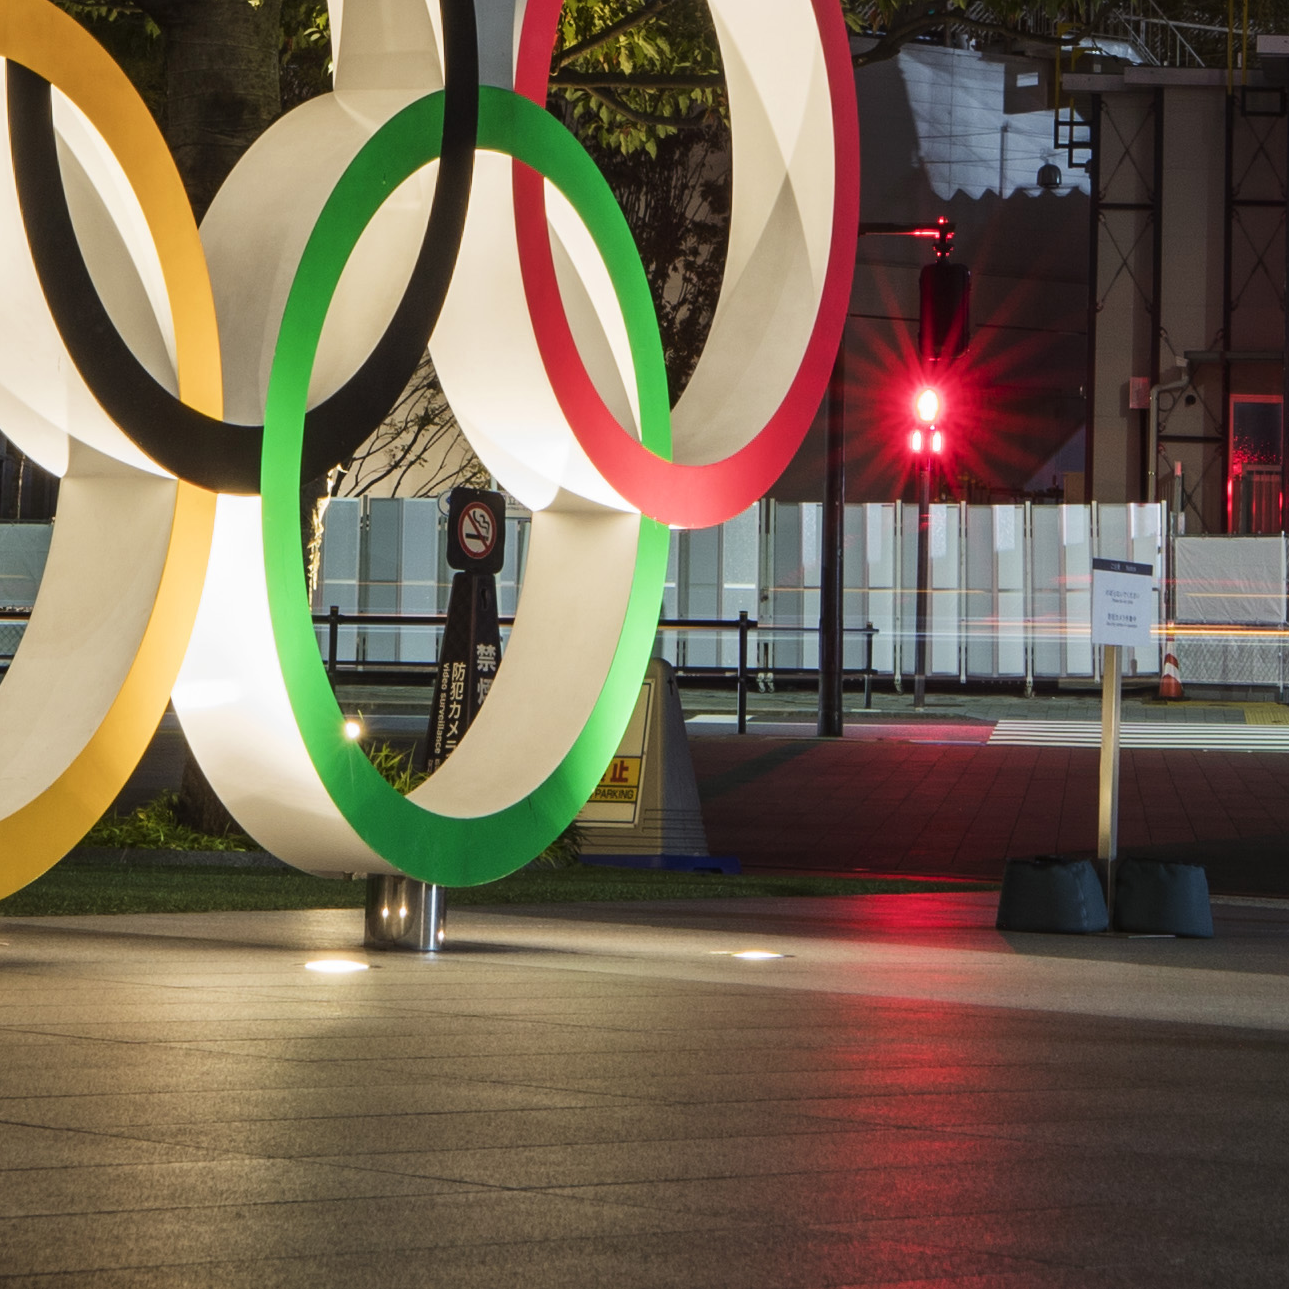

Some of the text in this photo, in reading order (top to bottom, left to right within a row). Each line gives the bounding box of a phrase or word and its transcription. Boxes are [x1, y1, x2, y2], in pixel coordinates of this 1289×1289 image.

[441, 662, 451, 690] video
[434, 692, 447, 754] surveillance
[594, 788, 634, 800] PARKING
